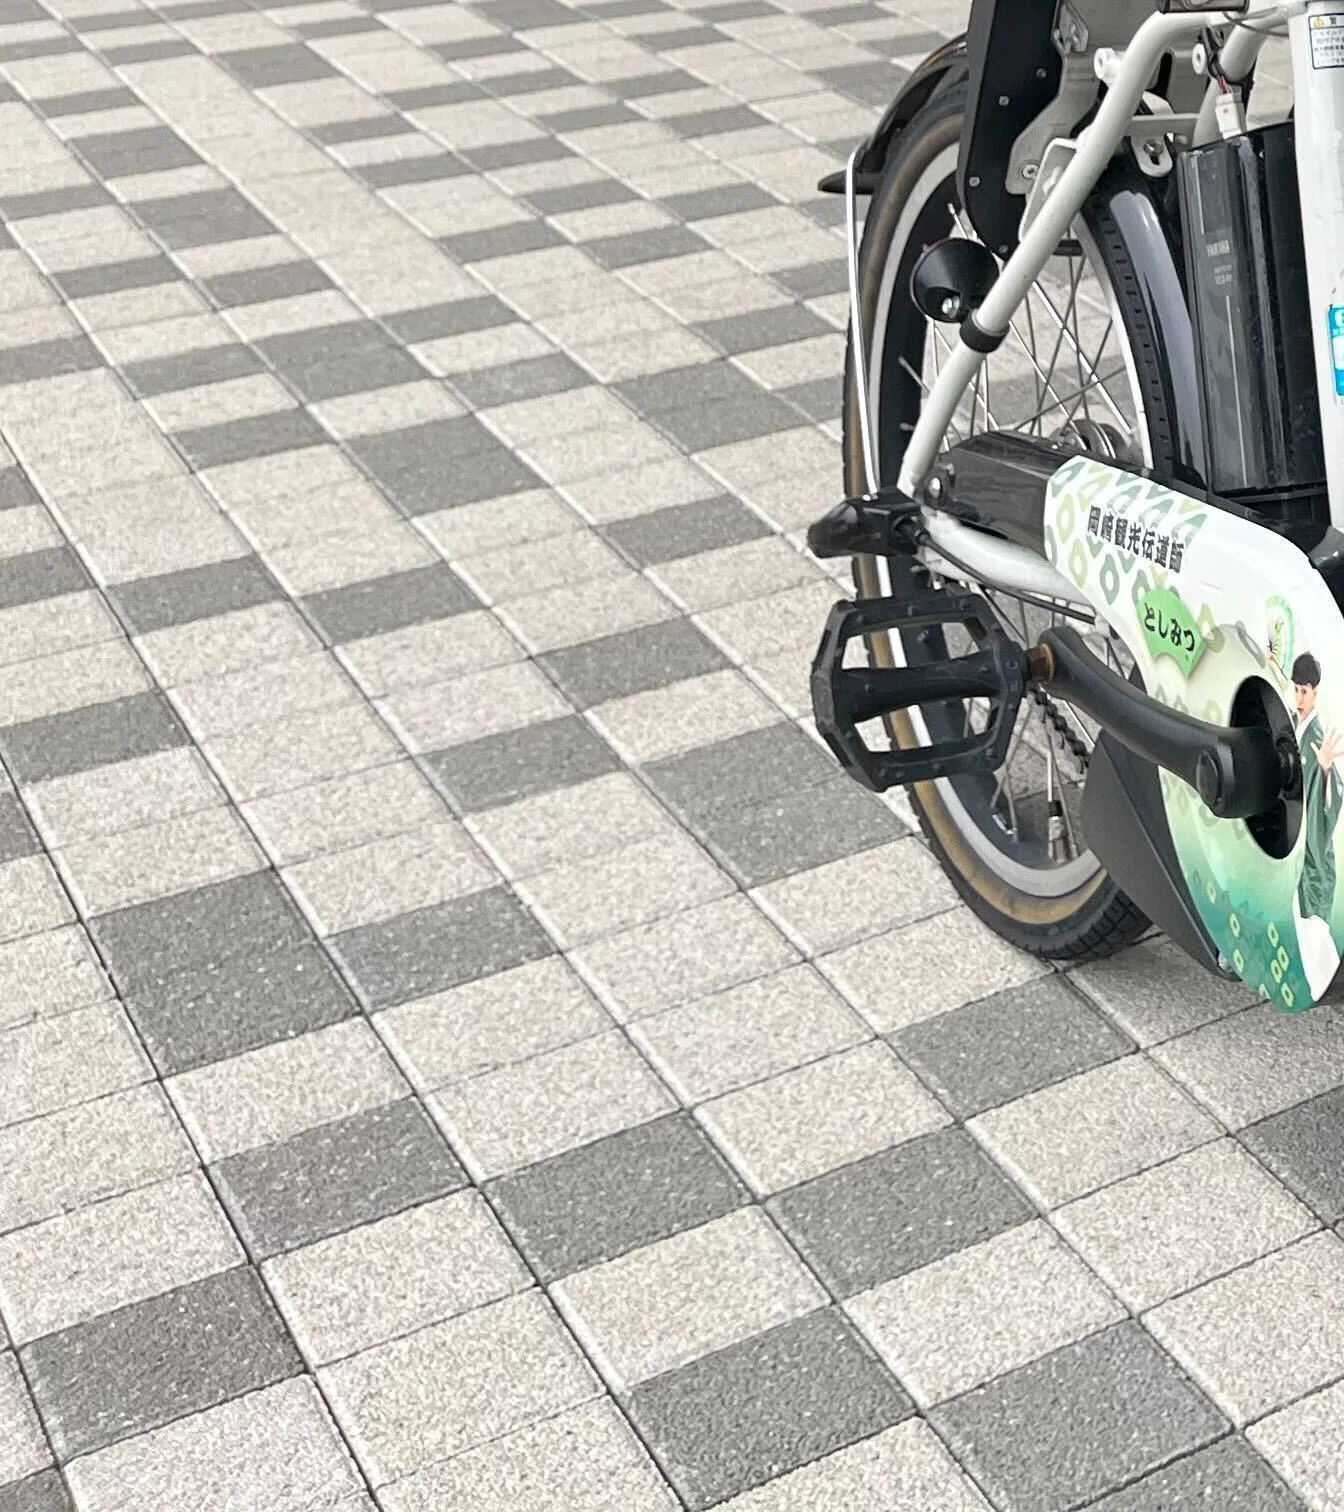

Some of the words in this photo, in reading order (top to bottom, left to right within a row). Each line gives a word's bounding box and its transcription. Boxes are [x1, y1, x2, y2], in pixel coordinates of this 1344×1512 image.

[1087, 505, 1184, 573] 岡崎観光伝道師
[1143, 603, 1195, 652] としみつ
